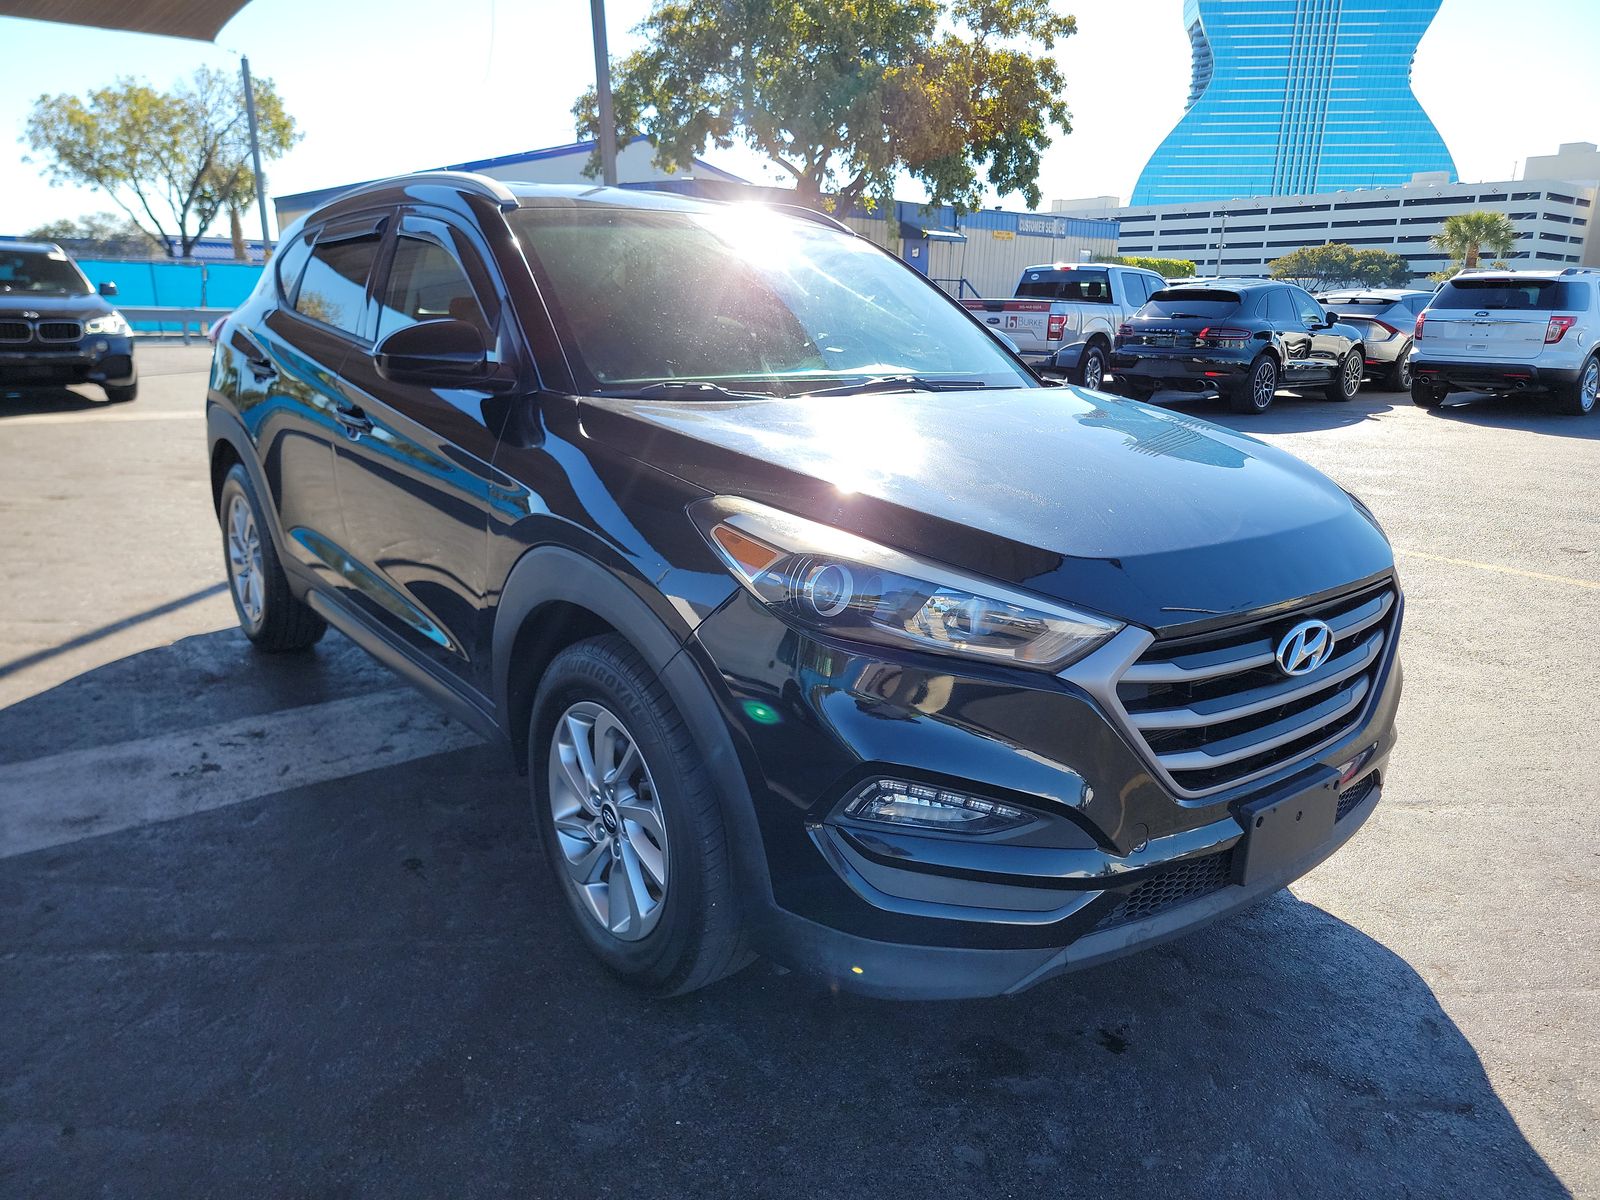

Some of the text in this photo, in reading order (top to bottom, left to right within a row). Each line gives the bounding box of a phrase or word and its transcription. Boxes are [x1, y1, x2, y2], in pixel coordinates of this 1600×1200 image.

[1019, 218, 1045, 233] CUSTOMER
[1018, 316, 1043, 327] BURKE
[568, 658, 641, 718] UNIROYAL
